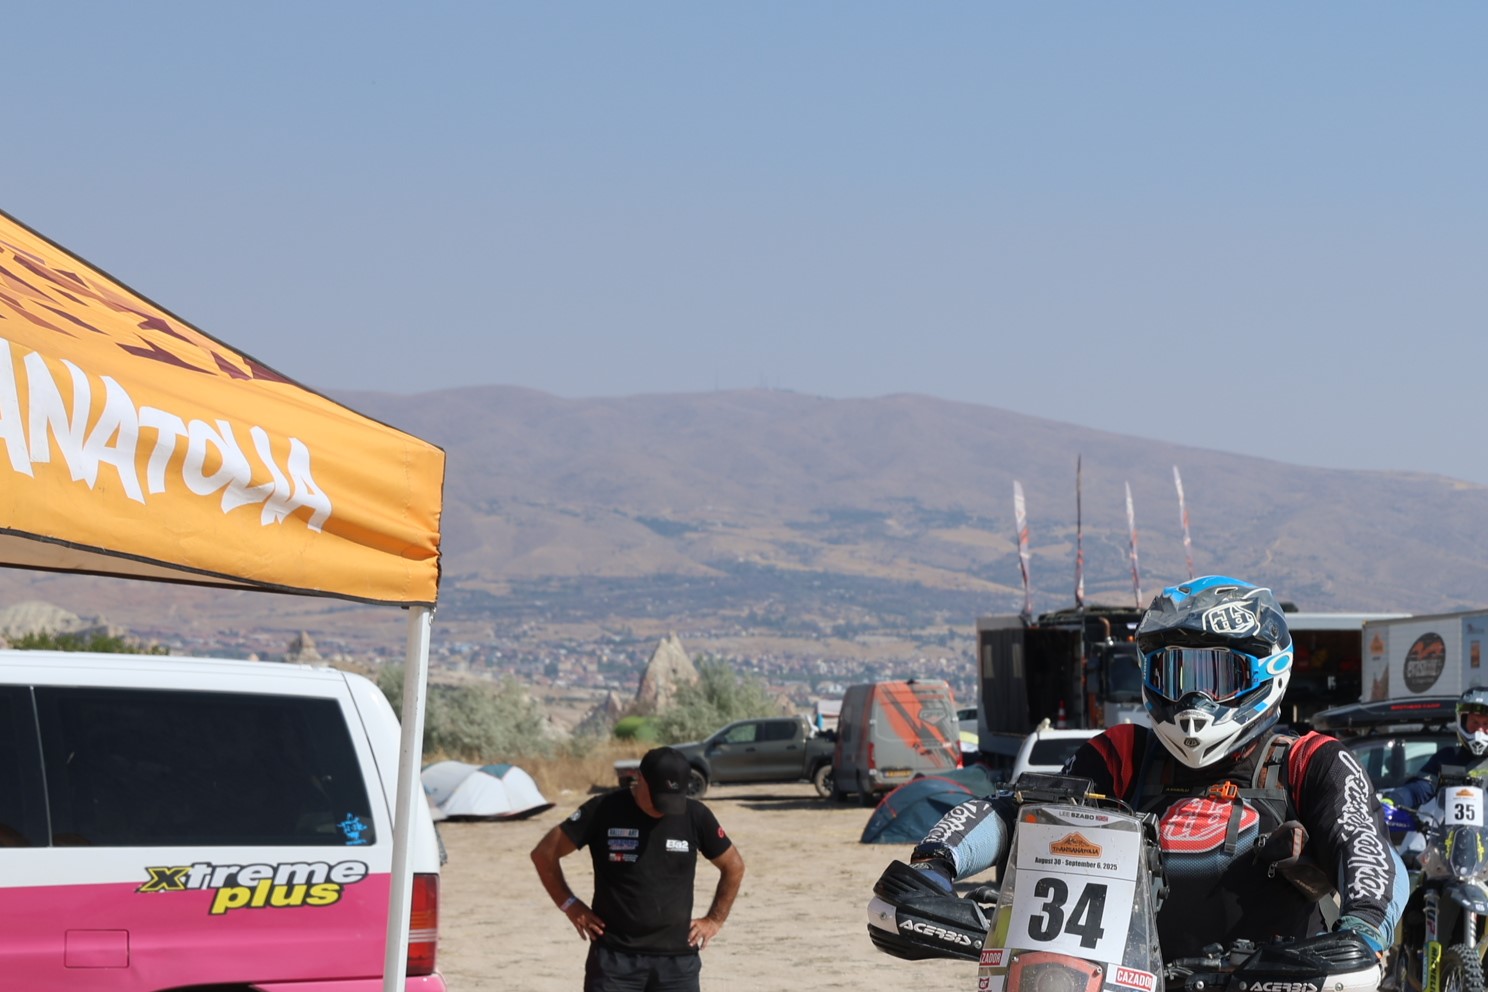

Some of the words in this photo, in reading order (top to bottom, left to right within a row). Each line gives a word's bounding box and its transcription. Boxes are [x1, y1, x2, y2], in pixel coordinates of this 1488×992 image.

[1071, 812, 1095, 821] SZABO
[1454, 803, 1475, 821] 35
[139, 861, 369, 893] xtreme
[1034, 857, 1054, 866] August
[1054, 858, 1062, 866] 30
[1065, 859, 1096, 869] September
[1103, 863, 1118, 871] 2025
[209, 878, 343, 916] plus
[1027, 877, 1108, 950] 34
[899, 919, 973, 946] ACERBIS
